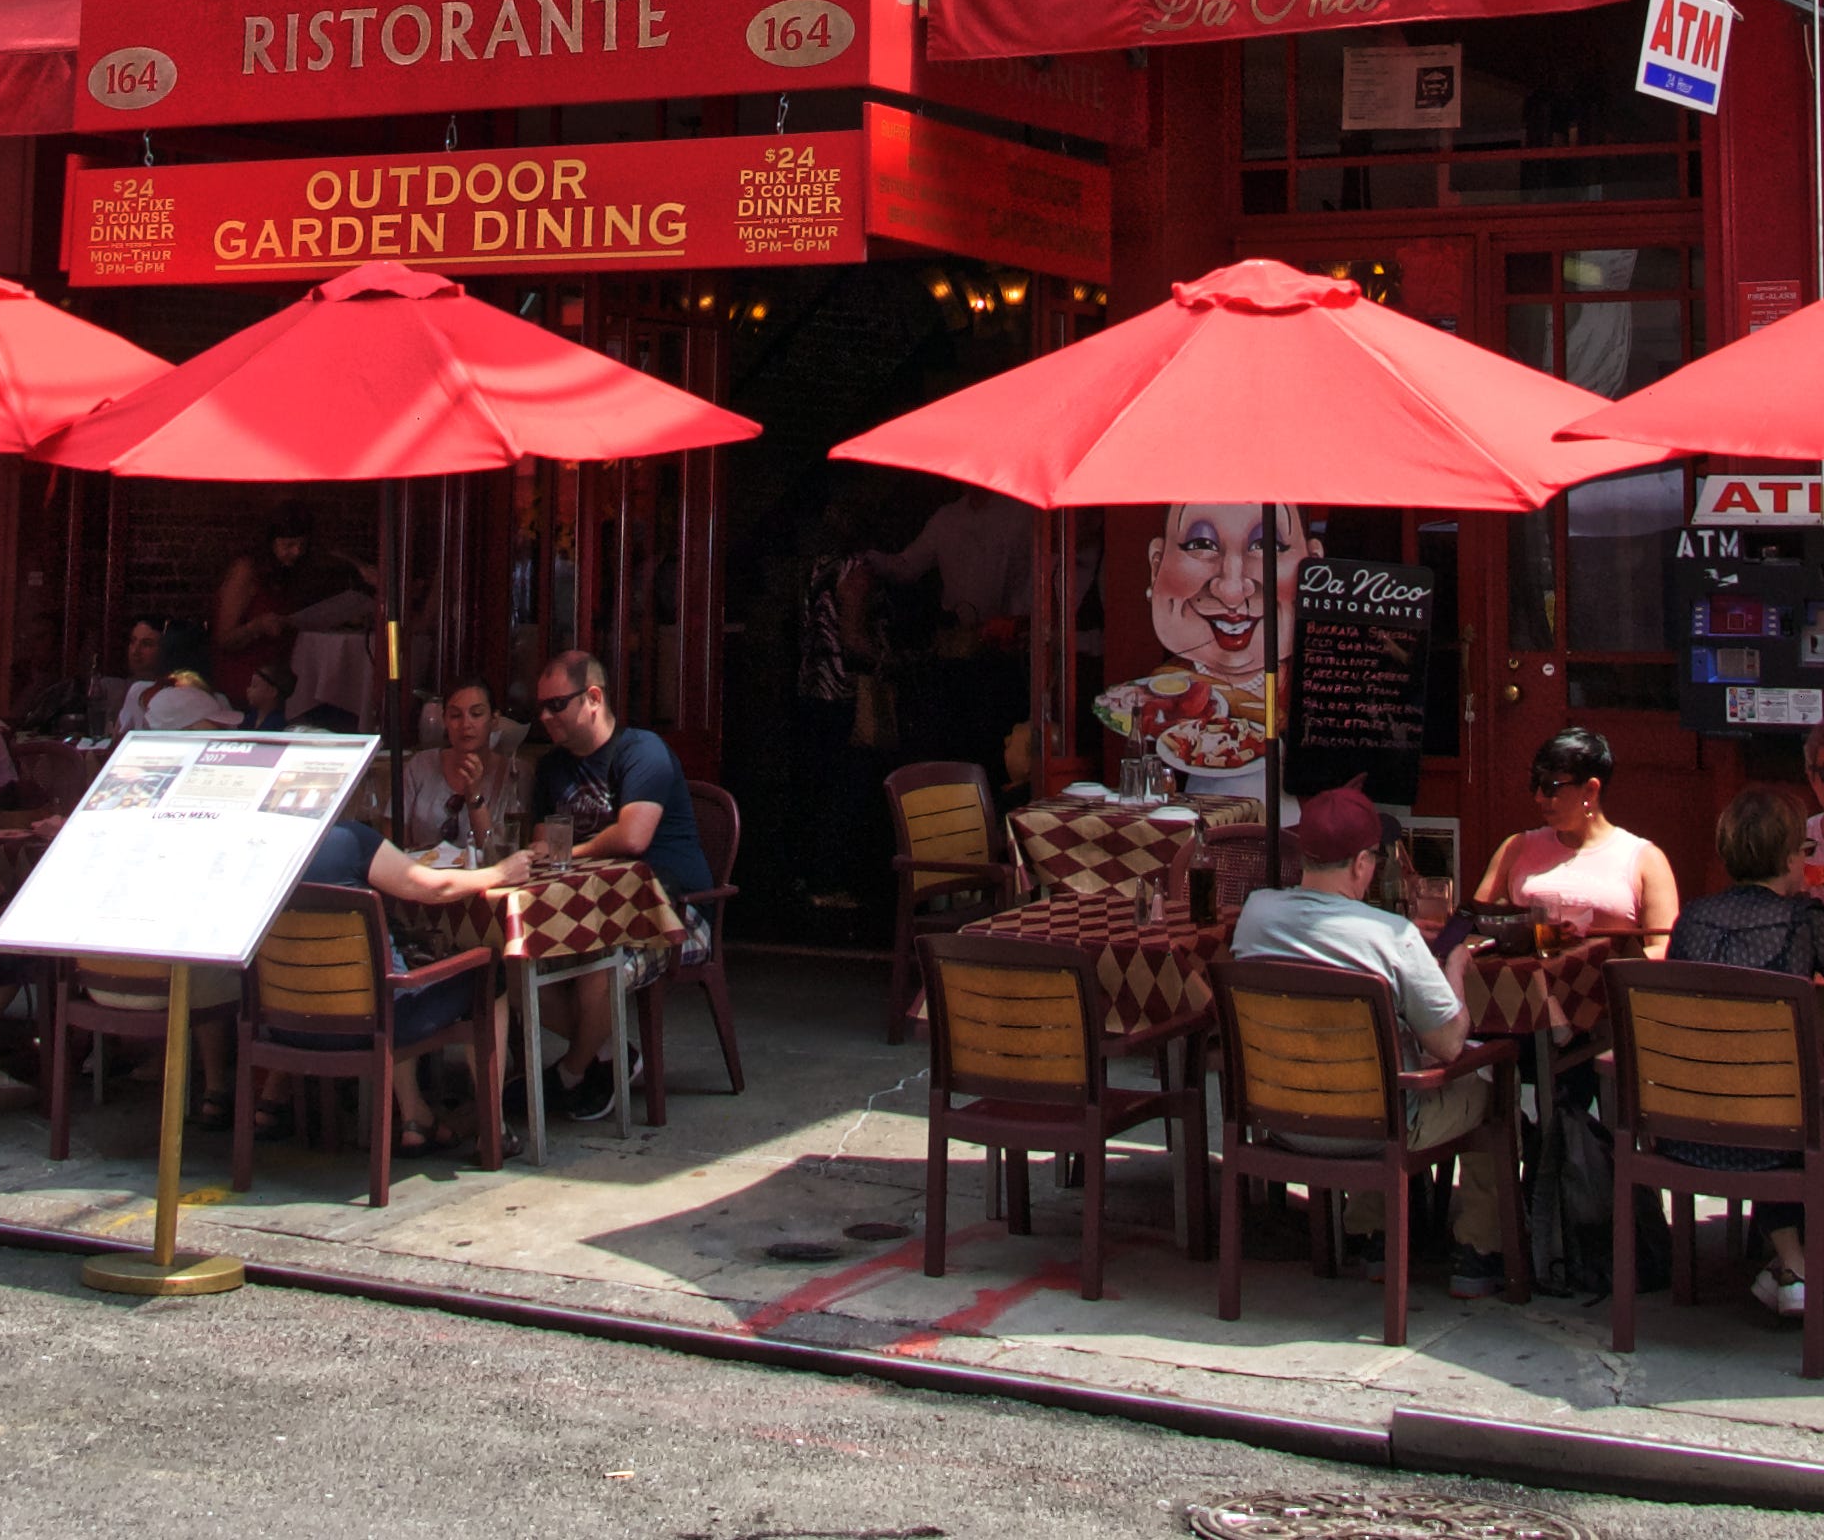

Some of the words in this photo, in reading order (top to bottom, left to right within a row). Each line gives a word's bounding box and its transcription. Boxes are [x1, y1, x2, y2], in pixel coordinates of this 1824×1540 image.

[762, 14, 833, 53] 164
[106, 60, 157, 99] 164
[765, 146, 816, 168] $24
[306, 158, 589, 211] OUTDOOR
[740, 168, 841, 185] PRIX-FIXE
[113, 178, 155, 199] $24
[744, 186, 754, 198] 3
[760, 183, 835, 197] COURSE
[738, 196, 842, 217] DINNER
[95, 215, 104, 225] 3
[109, 211, 170, 224] COURSE
[90, 223, 175, 242] DINNER
[213, 212, 447, 260] GARDEN
[473, 200, 689, 253] DINING
[1677, 530, 1739, 558] ATM
[1299, 565, 1345, 594] Da
[1352, 568, 1431, 602] Nico
[1302, 597, 1425, 620] RISTORANTE
